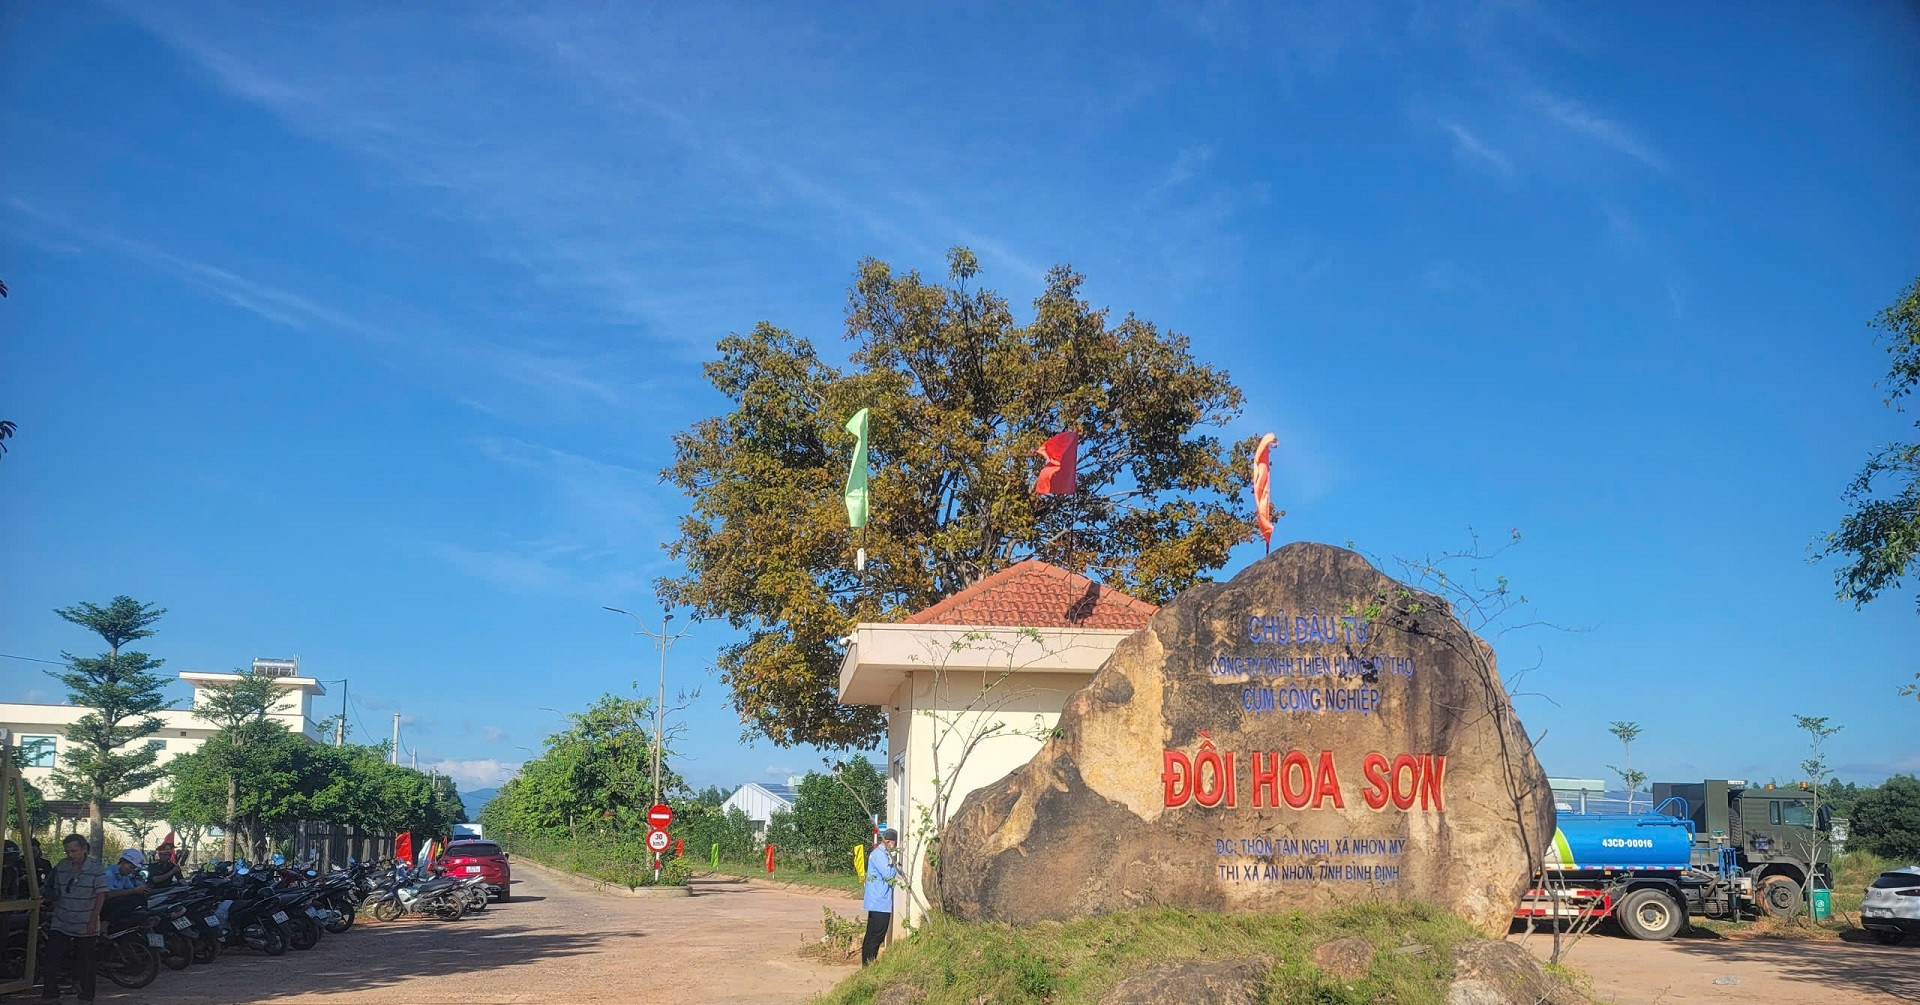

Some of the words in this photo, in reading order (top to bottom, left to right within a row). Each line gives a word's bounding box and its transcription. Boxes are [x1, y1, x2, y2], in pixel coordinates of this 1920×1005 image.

[1249, 608, 1289, 645] CHỦ
[1294, 606, 1337, 644] ĐẦU
[1210, 653, 1244, 676] CÔNG
[1246, 657, 1260, 676] TY
[1263, 657, 1294, 676] TNHH
[1296, 652, 1331, 676] THIÊN
[1242, 688, 1274, 717] CỤM
[1279, 683, 1320, 711] CÔNG
[1325, 683, 1380, 717] NGHIỆP
[1161, 729, 1236, 809] ĐỒI
[1252, 750, 1345, 810] HOA
[1362, 752, 1446, 812] SƠN
[1216, 839, 1237, 855] ĐC:
[1240, 835, 1273, 855] THÔN
[1275, 835, 1299, 855] TÂN
[1335, 835, 1350, 854] XÃ
[1352, 839, 1386, 855] NHƠN
[1389, 835, 1406, 855] MỸ
[1602, 838, 1653, 848] 43CD-00016
[1218, 865, 1240, 886] THỊ
[1243, 861, 1260, 881] XÃ
[1263, 865, 1279, 881] AN
[1281, 865, 1315, 882] NHƠN,
[1345, 860, 1372, 881] BÌNH
[1374, 865, 1400, 886] ĐỊNH
